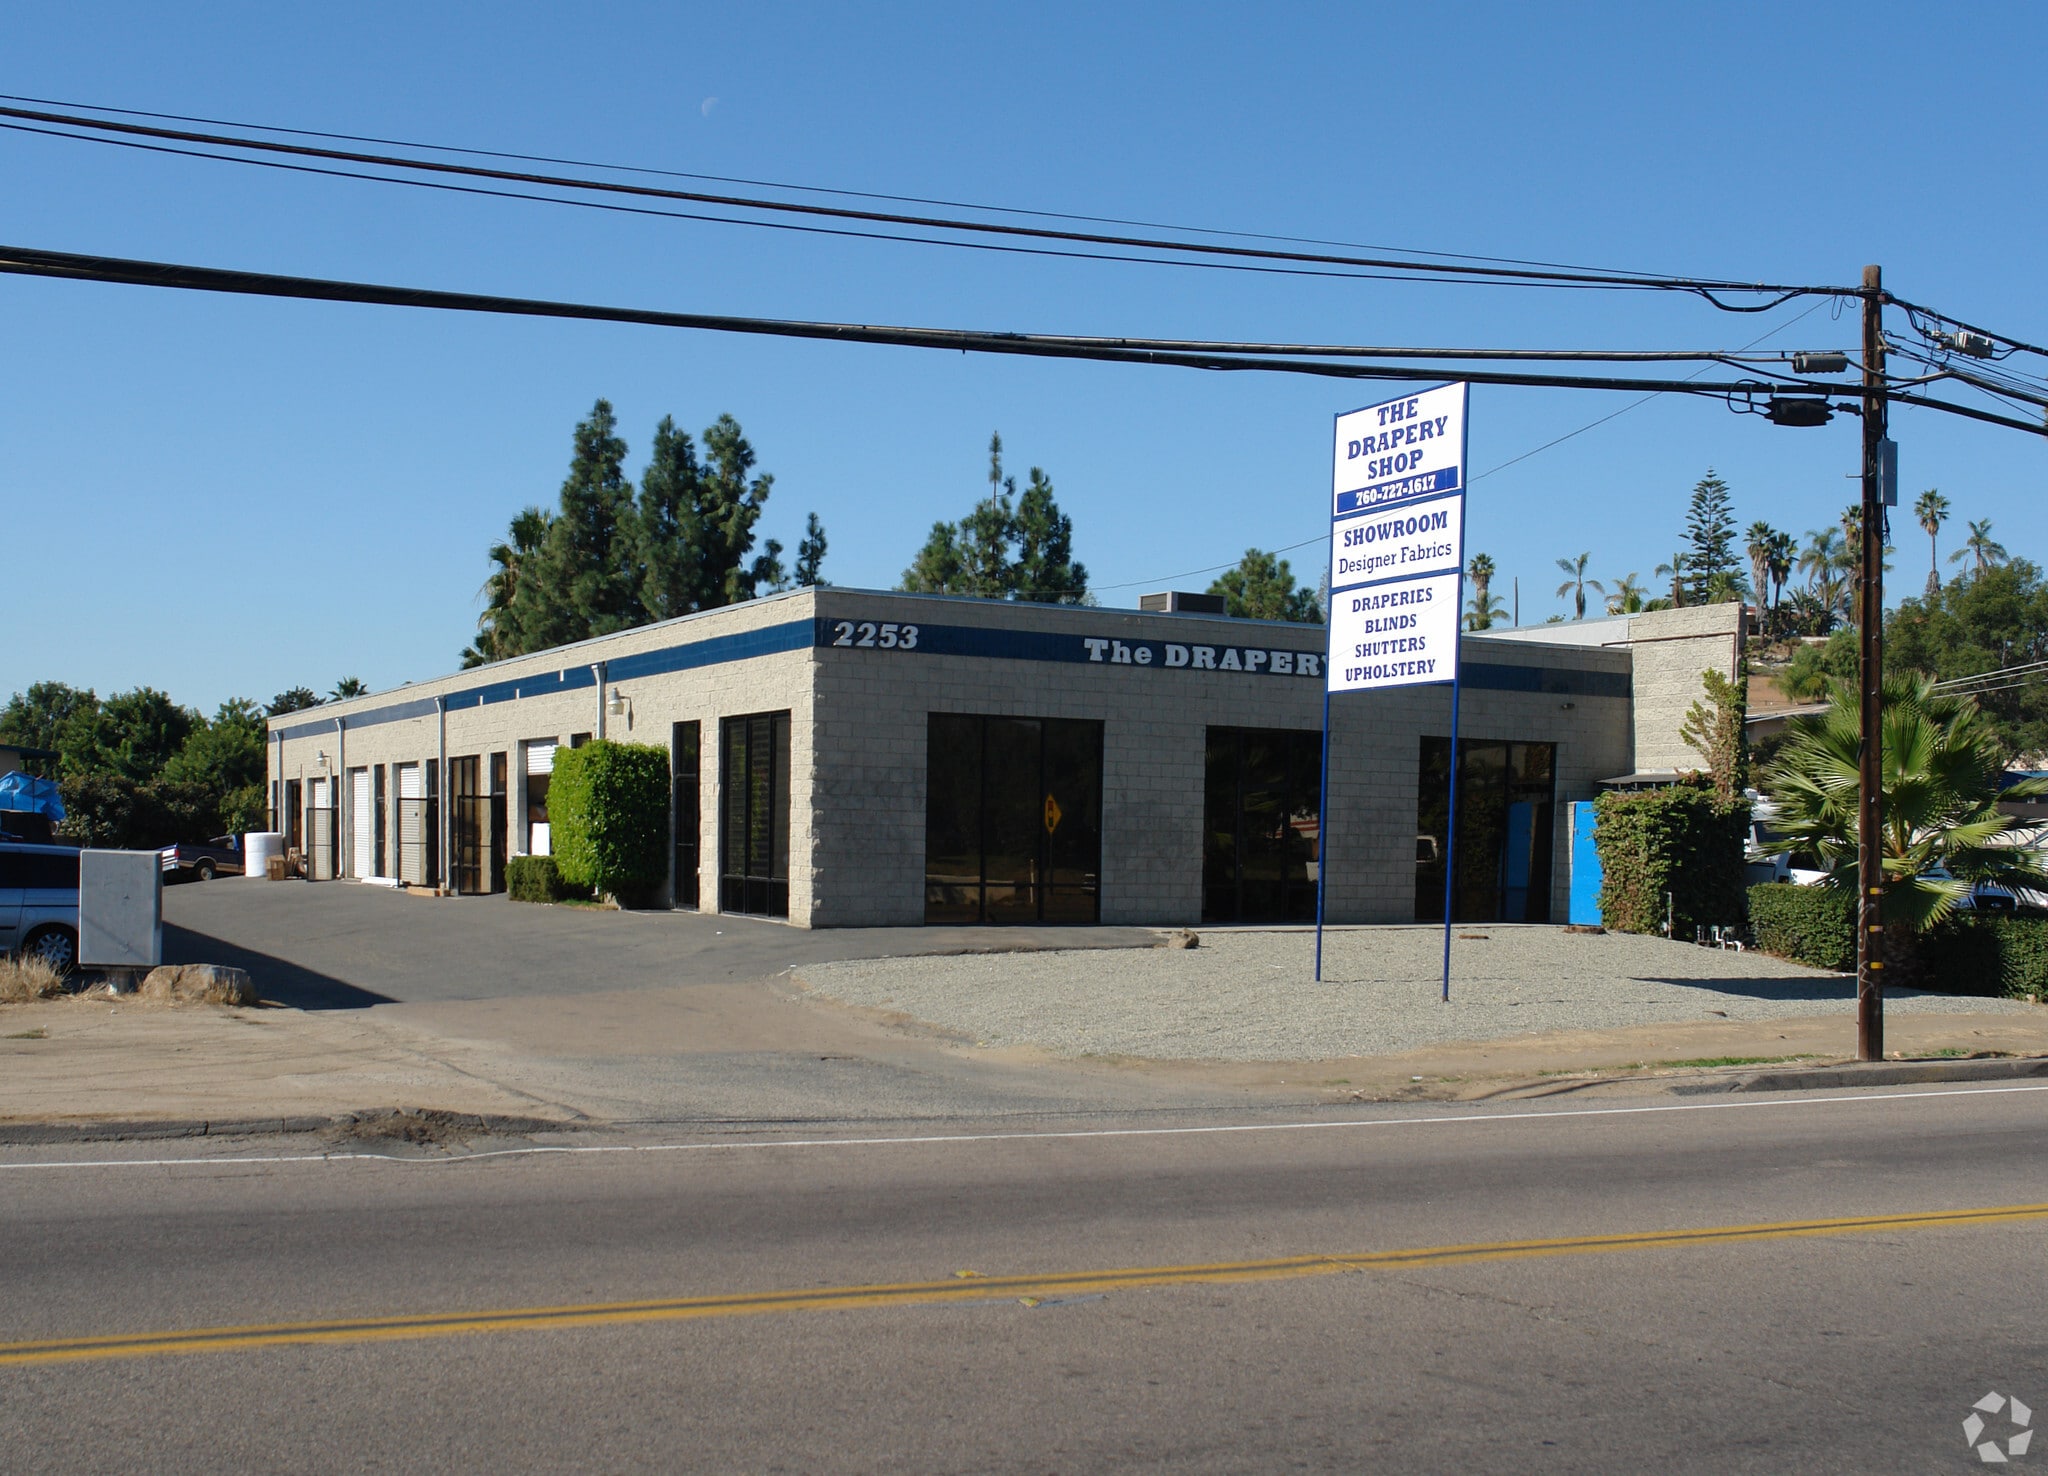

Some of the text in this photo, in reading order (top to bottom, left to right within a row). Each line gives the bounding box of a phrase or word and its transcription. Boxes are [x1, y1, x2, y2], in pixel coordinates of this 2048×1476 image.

[1377, 398, 1419, 426] THE
[1347, 415, 1448, 460] DRAPERY
[1367, 449, 1423, 480] SHOP
[1355, 474, 1436, 506] 760-727-1617
[1344, 511, 1448, 548] SHOWROOM
[1338, 541, 1452, 574] Designer Fabrics
[1352, 587, 1433, 613] DRAPERIES
[832, 621, 919, 649] 2253
[1365, 613, 1417, 634] BLINDS
[1084, 638, 1327, 676] The DRAPER
[1355, 636, 1426, 658] SHUTTERS
[1345, 659, 1436, 682] UPHOLSTERY
